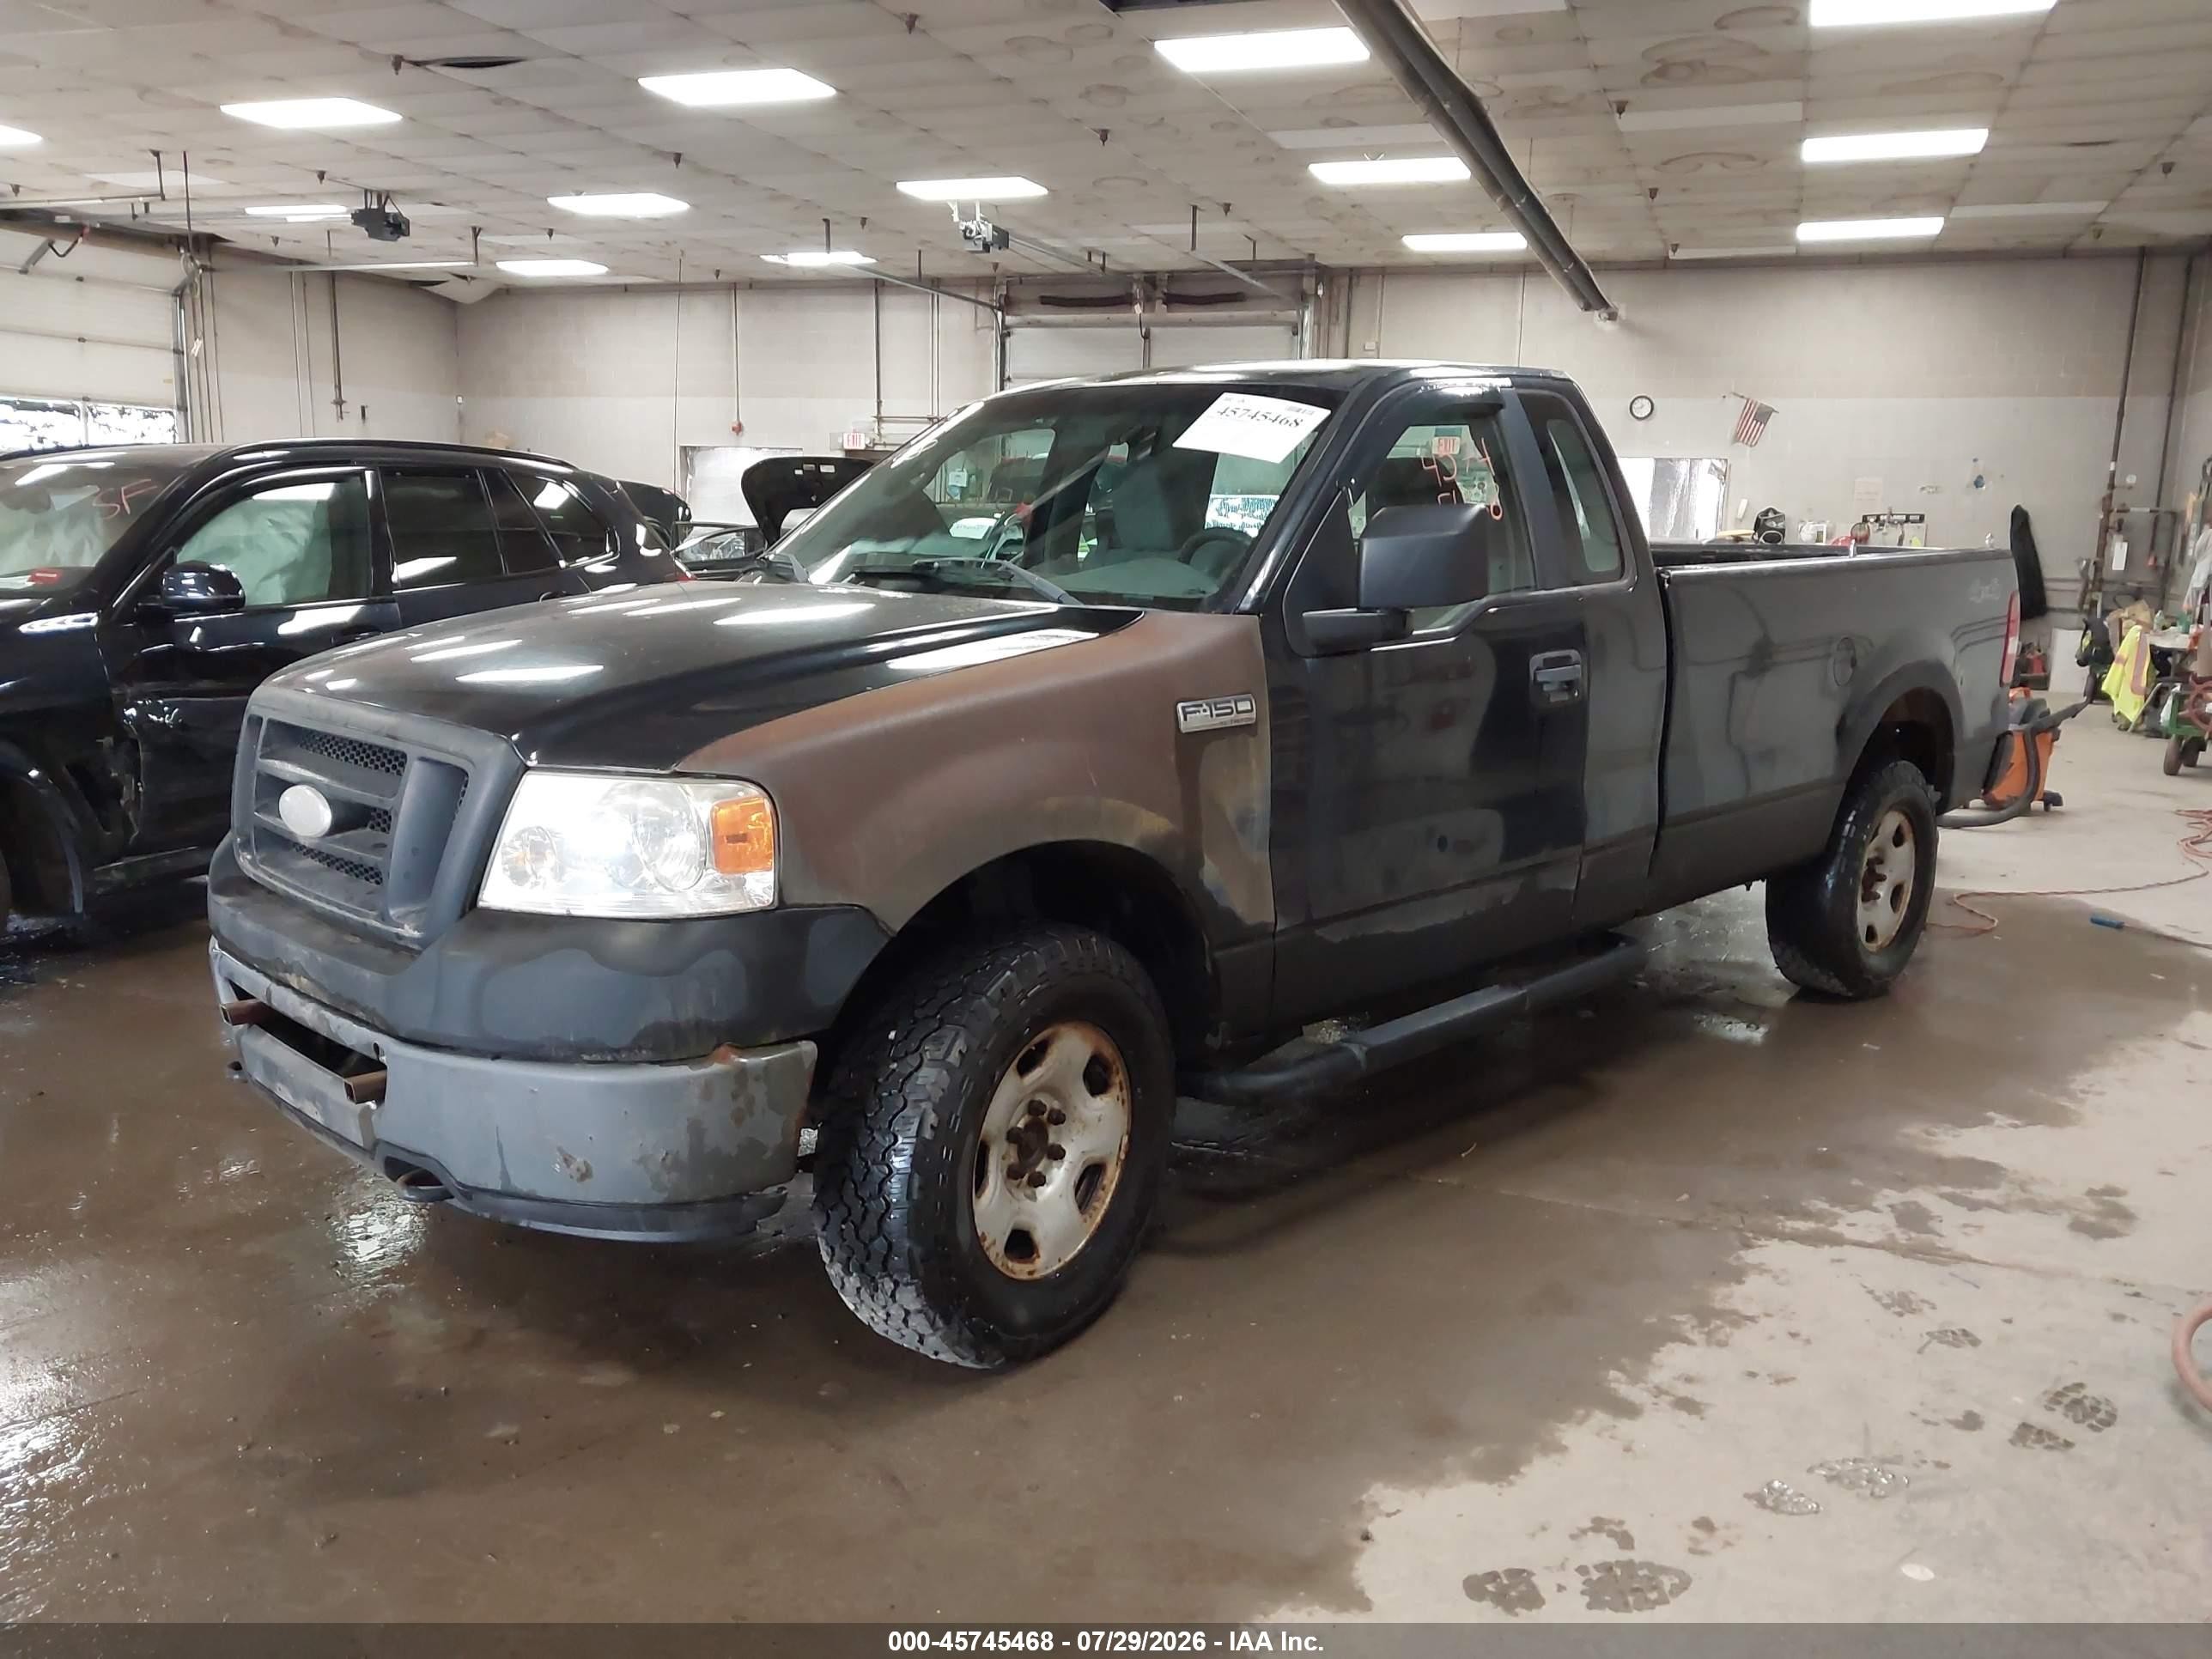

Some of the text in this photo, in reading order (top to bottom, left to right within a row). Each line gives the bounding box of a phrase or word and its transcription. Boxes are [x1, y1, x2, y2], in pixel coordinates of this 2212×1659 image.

[1217, 406, 1304, 428] 45745468
[847, 434, 862, 447] EXIT
[1437, 438, 1457, 454] EXIT
[92, 478, 158, 520] SF
